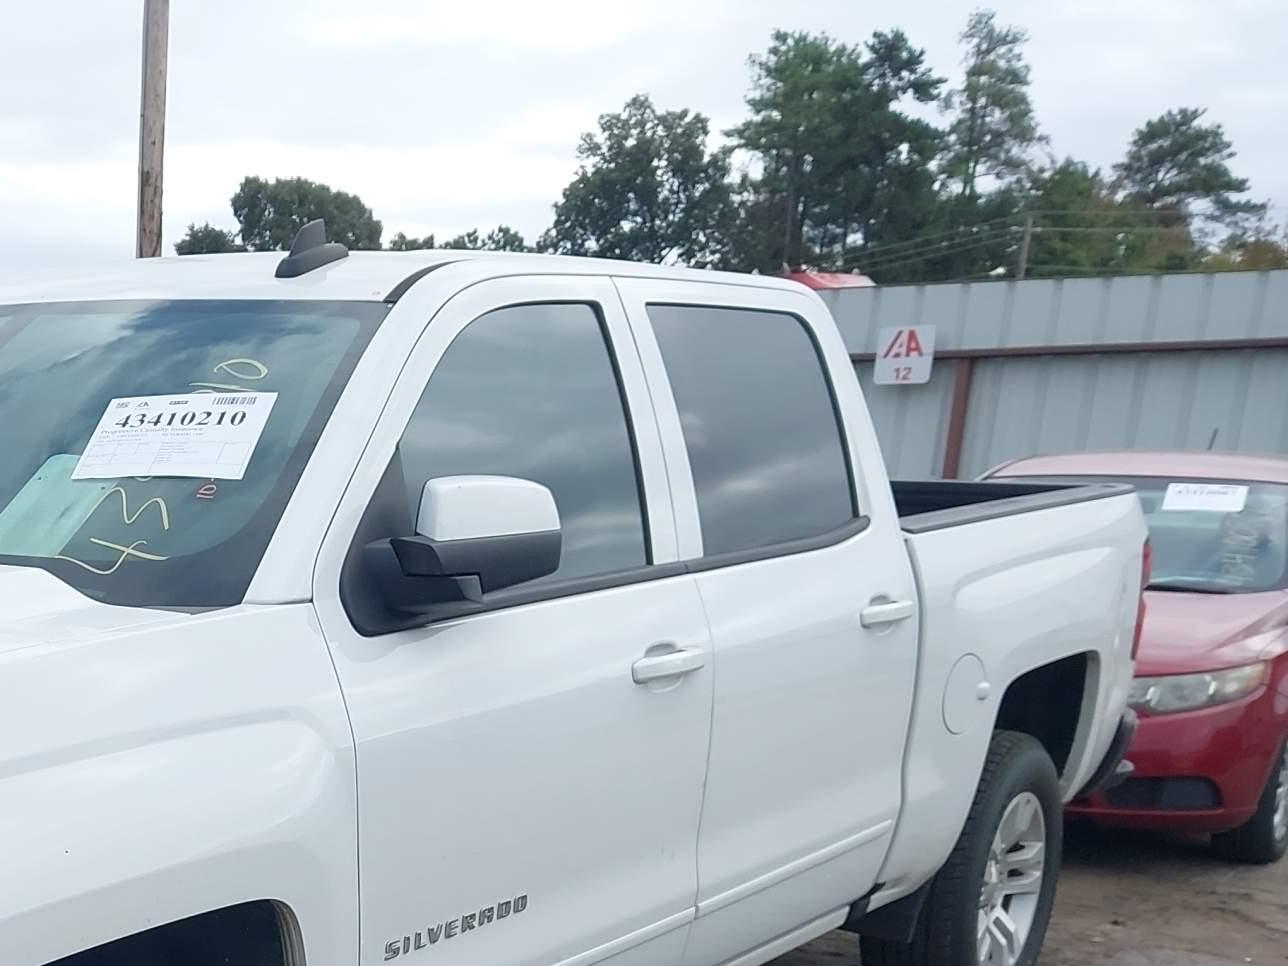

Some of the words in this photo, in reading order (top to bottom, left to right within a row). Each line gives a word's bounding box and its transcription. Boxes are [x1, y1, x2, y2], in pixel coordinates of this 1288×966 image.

[894, 367, 913, 381] 12
[114, 410, 247, 428] 43410210
[383, 895, 528, 961] SILVERADO
